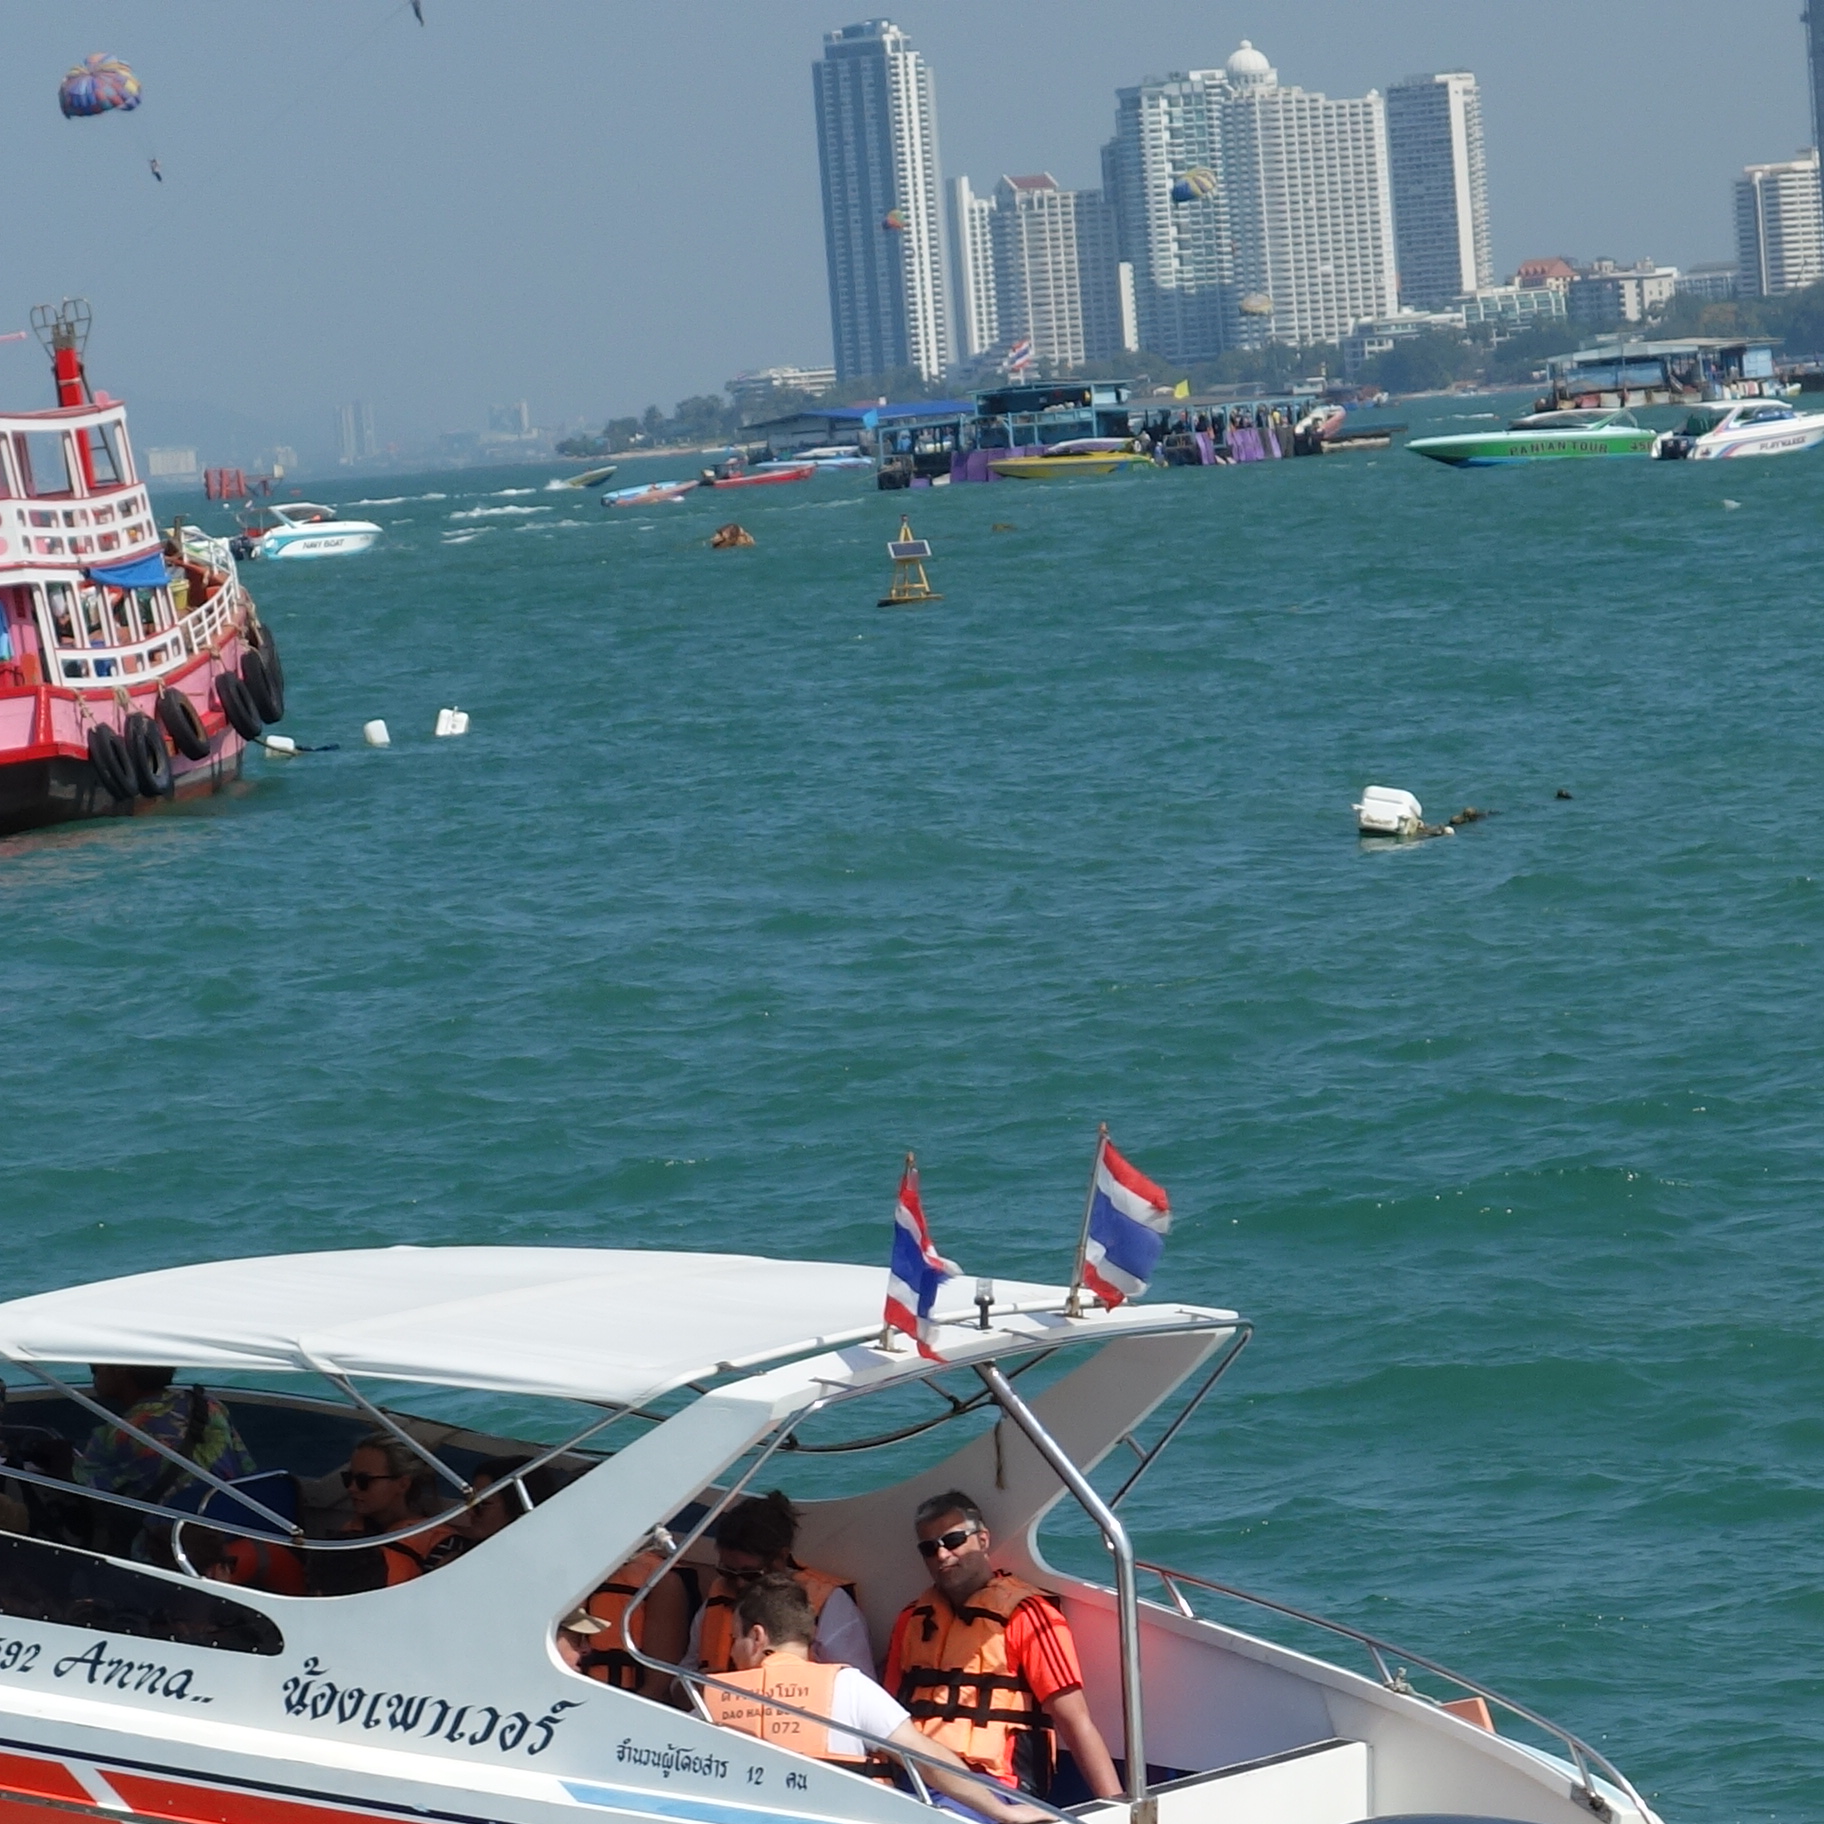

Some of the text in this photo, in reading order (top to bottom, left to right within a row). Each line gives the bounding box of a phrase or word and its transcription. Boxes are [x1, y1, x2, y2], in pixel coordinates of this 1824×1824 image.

[1571, 441, 1608, 454] TOUR
[282, 1656, 590, 1756] น้องเพาเวอร์
[722, 1709, 744, 1720] DAO
[772, 1722, 801, 1734] 072
[746, 1765, 765, 1786] 12
[786, 1771, 808, 1791] คน
